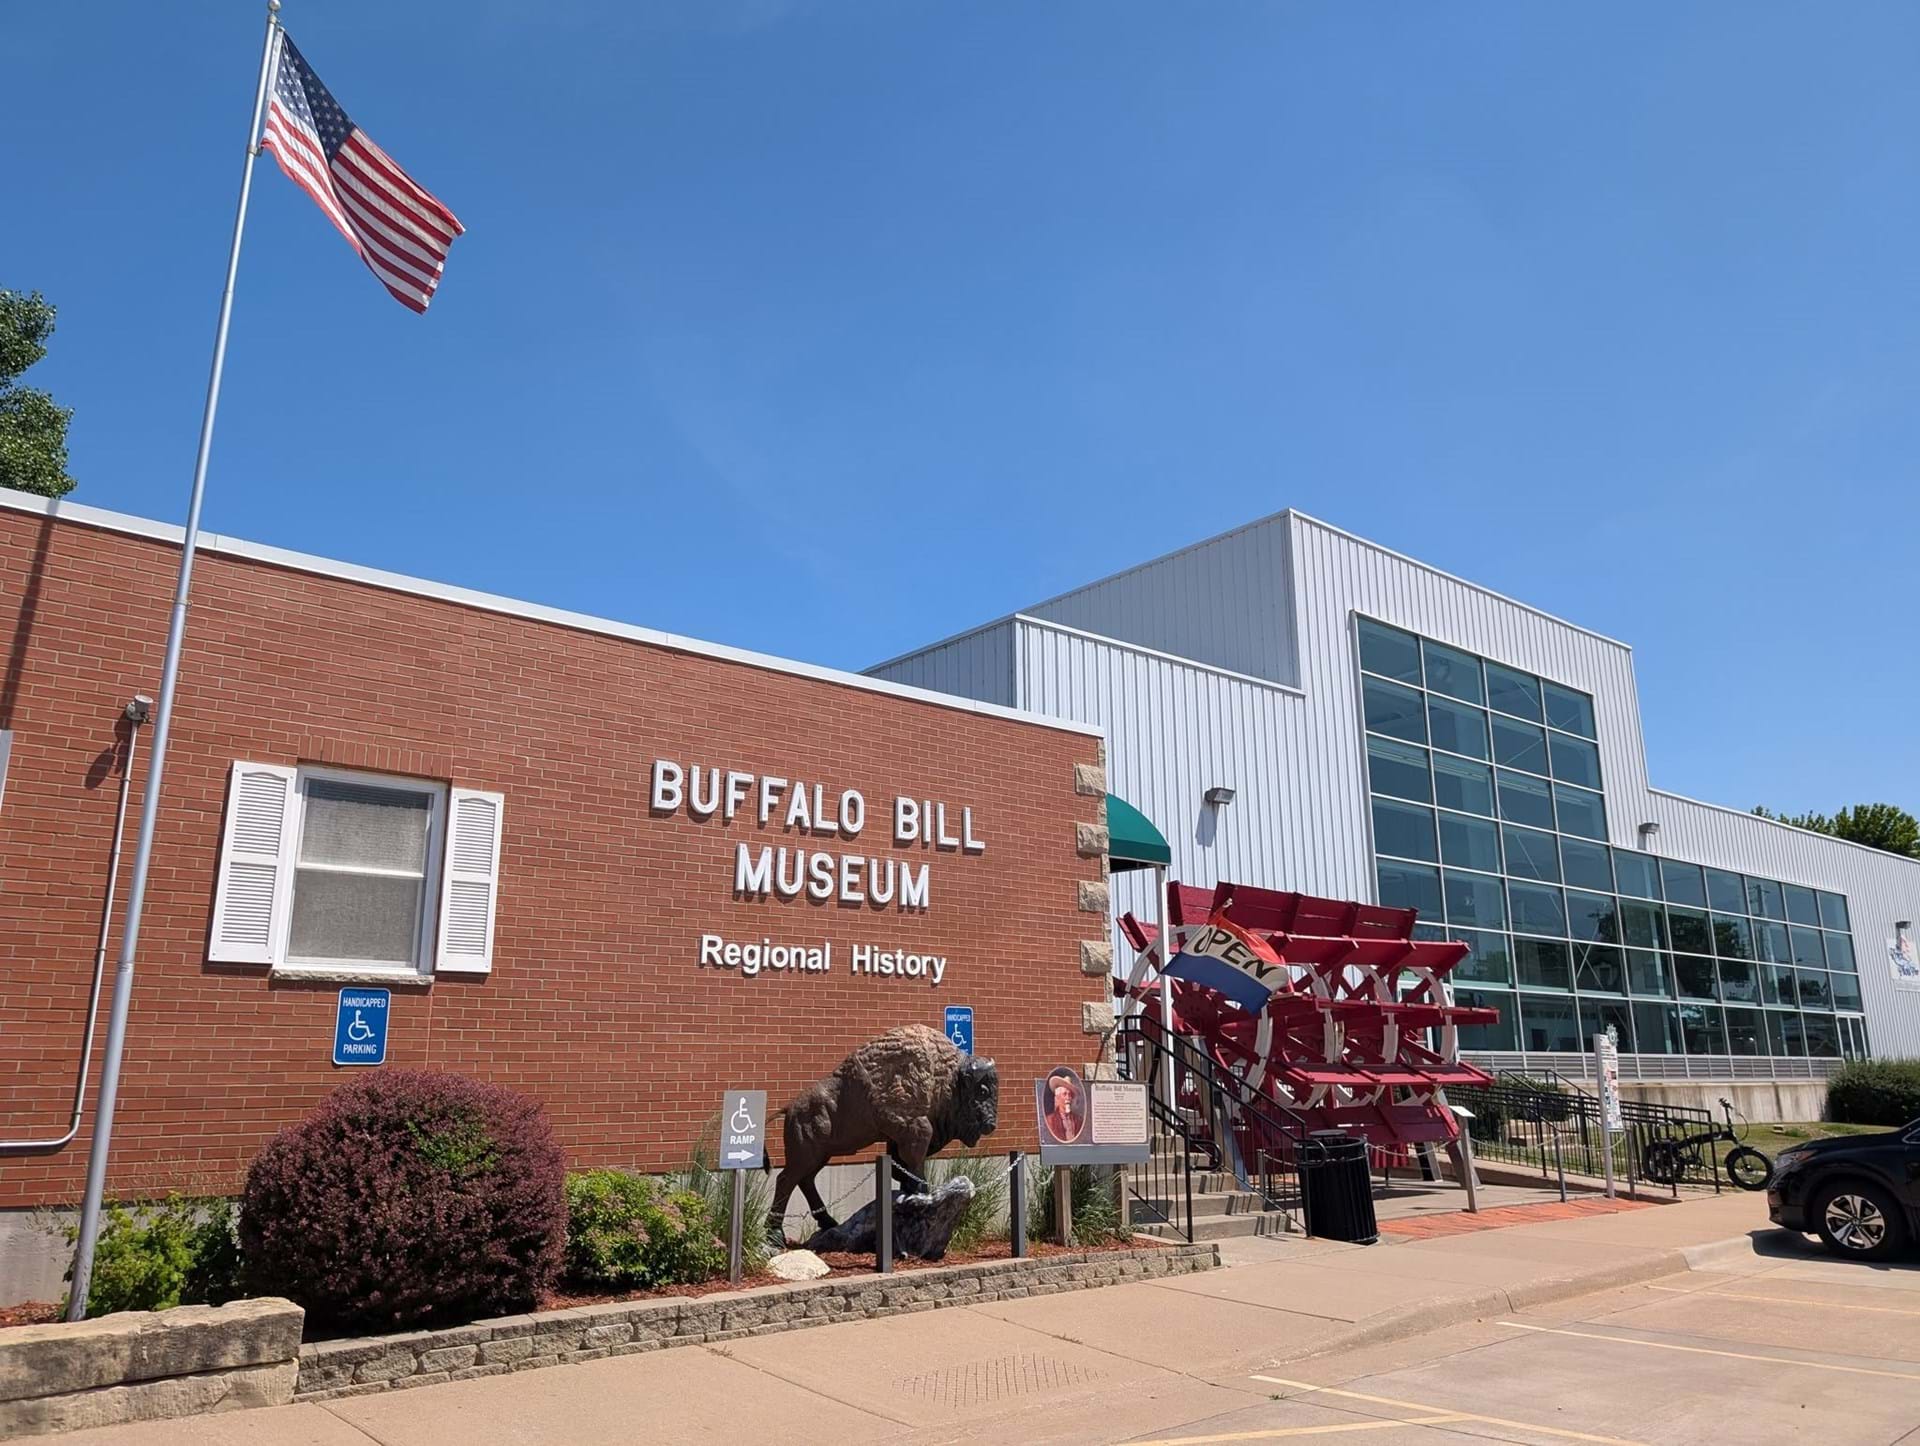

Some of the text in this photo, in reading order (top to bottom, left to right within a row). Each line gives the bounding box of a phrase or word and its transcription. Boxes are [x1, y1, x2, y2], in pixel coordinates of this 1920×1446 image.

[652, 759, 986, 850] BUFFALO BILL
[735, 843, 930, 908] MUSEUM
[700, 934, 947, 983] Regional History
[1194, 927, 1278, 979] OPEN
[342, 997, 386, 1008] HANDICAPPED
[343, 1043, 377, 1054] PARKING
[729, 1135, 755, 1144] RAMP
